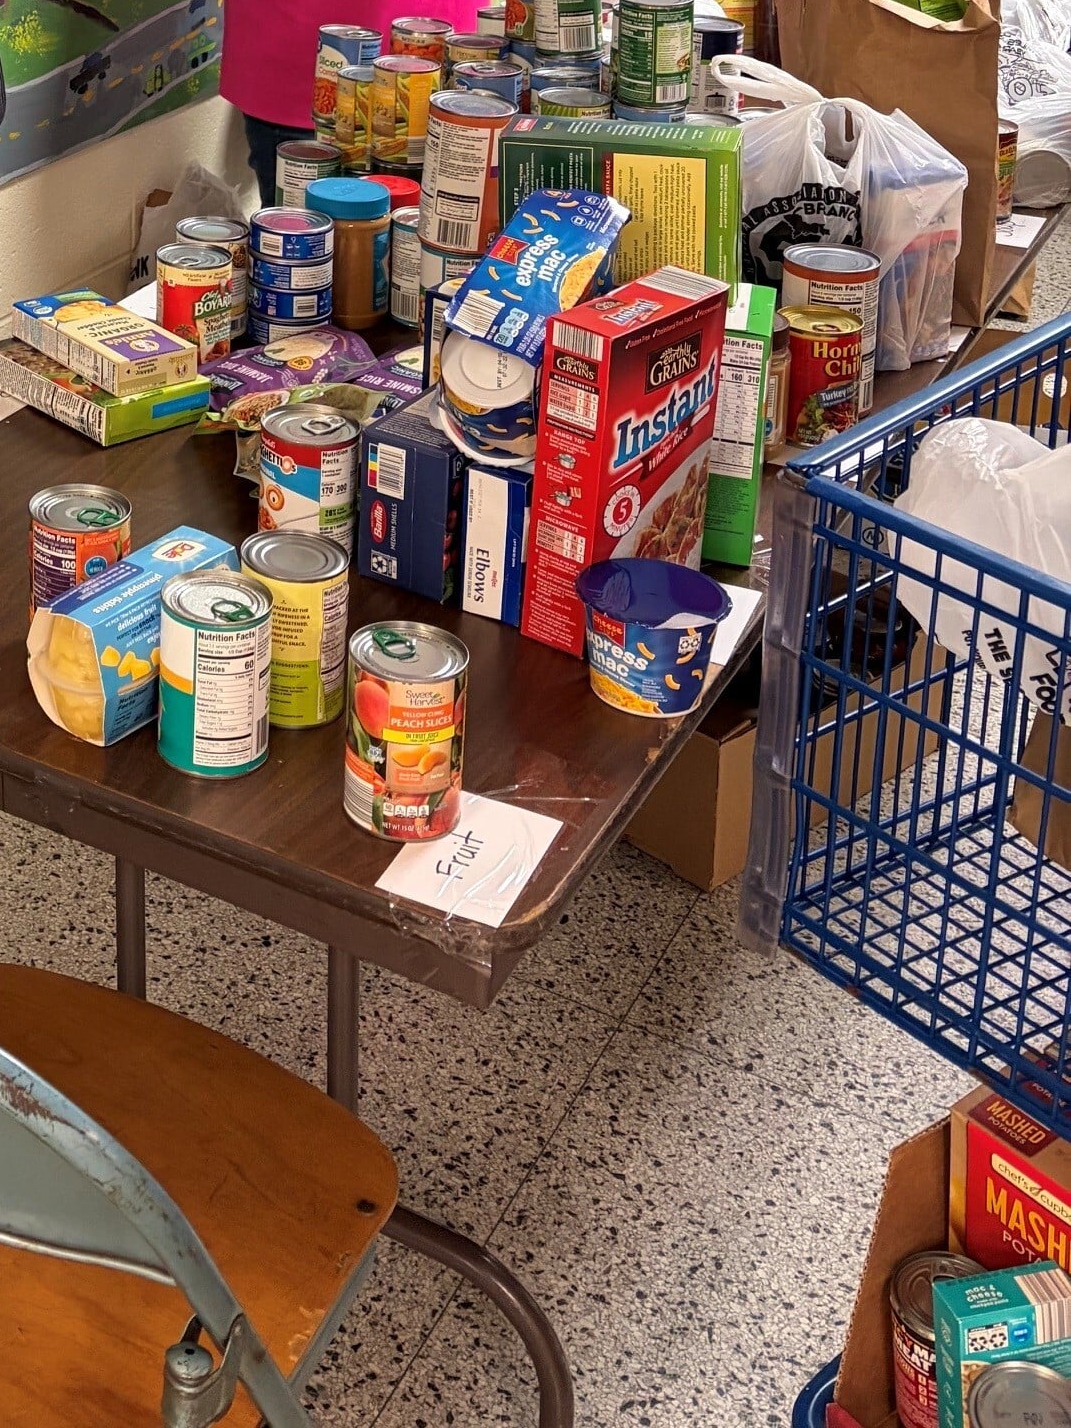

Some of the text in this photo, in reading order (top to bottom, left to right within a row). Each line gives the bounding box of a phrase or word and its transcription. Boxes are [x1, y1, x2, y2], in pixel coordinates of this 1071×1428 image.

[803, 202, 857, 222] BRANC
[515, 234, 559, 287] express
[536, 249, 567, 282] mac
[810, 281, 863, 291] Nutrition Facts
[193, 293, 233, 317] BOYARD
[662, 341, 693, 368] earthly
[741, 340, 763, 351] Facts
[813, 341, 861, 359] Horm
[355, 373, 383, 386] RICE
[555, 358, 596, 381] GRAINS
[649, 354, 697, 387] GRAINS
[730, 372, 760, 384] 160 310
[824, 360, 861, 378] Chil
[820, 387, 847, 403] Turkey
[612, 353, 718, 470] Instant
[321, 449, 349, 458] Nutrition
[648, 425, 690, 472] White Rice
[321, 483, 348, 495] 170 300
[618, 499, 629, 521] 5
[373, 504, 383, 539] Barilla
[56, 534, 76, 544] Facts
[390, 525, 398, 551] MEDIUM
[60, 560, 76, 569] 100
[474, 547, 490, 603] Elbows
[120, 572, 163, 598] pineapple
[92, 595, 123, 615] tidbits
[116, 603, 158, 632] delicious fruit
[198, 631, 256, 642] Nutrition Facts
[984, 627, 1012, 663] THE
[197, 660, 254, 673] Calories 60
[592, 648, 630, 678] mac
[405, 689, 434, 700] Sweet
[409, 694, 445, 707] Harvest
[390, 714, 453, 729] PEACH SLICES
[435, 830, 484, 880] Fruit
[986, 1100, 1047, 1145] MASHED
[987, 1115, 1027, 1146] POTATOES
[997, 1161, 1071, 1220] chef's cupb
[986, 1176, 1071, 1273] MASH
[964, 1284, 986, 1297] mac
[966, 1290, 1004, 1303] cheese
